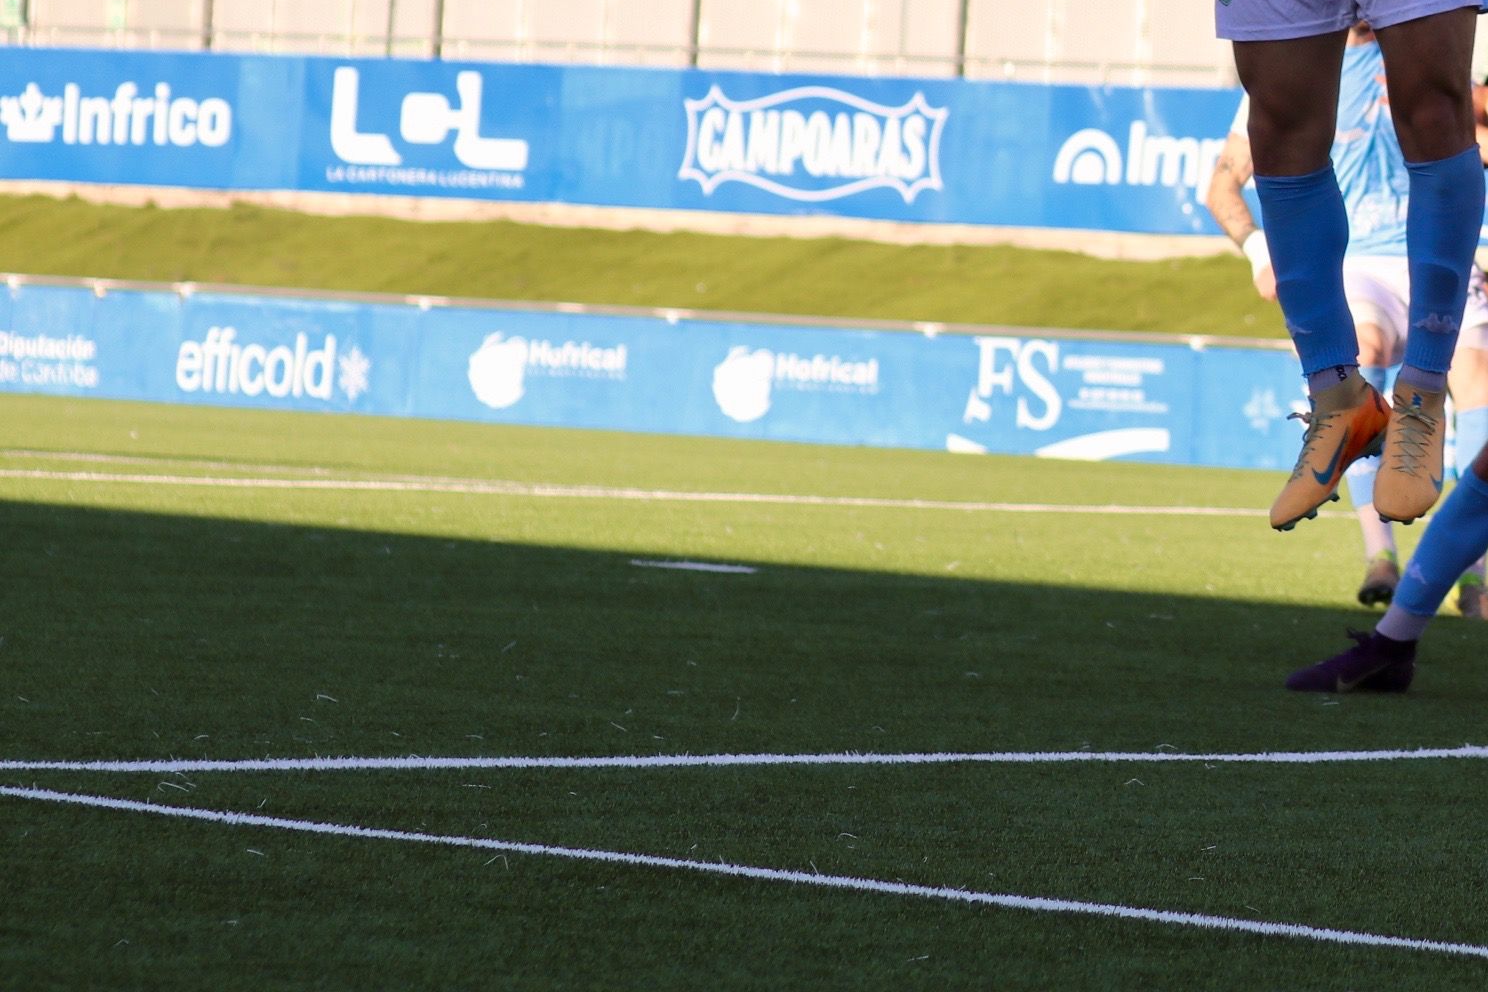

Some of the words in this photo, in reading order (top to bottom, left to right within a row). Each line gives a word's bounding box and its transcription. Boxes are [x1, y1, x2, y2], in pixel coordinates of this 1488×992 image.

[62, 81, 233, 147] Infrico
[698, 108, 928, 181] CAMPOARAS
[176, 326, 337, 401] efficold
